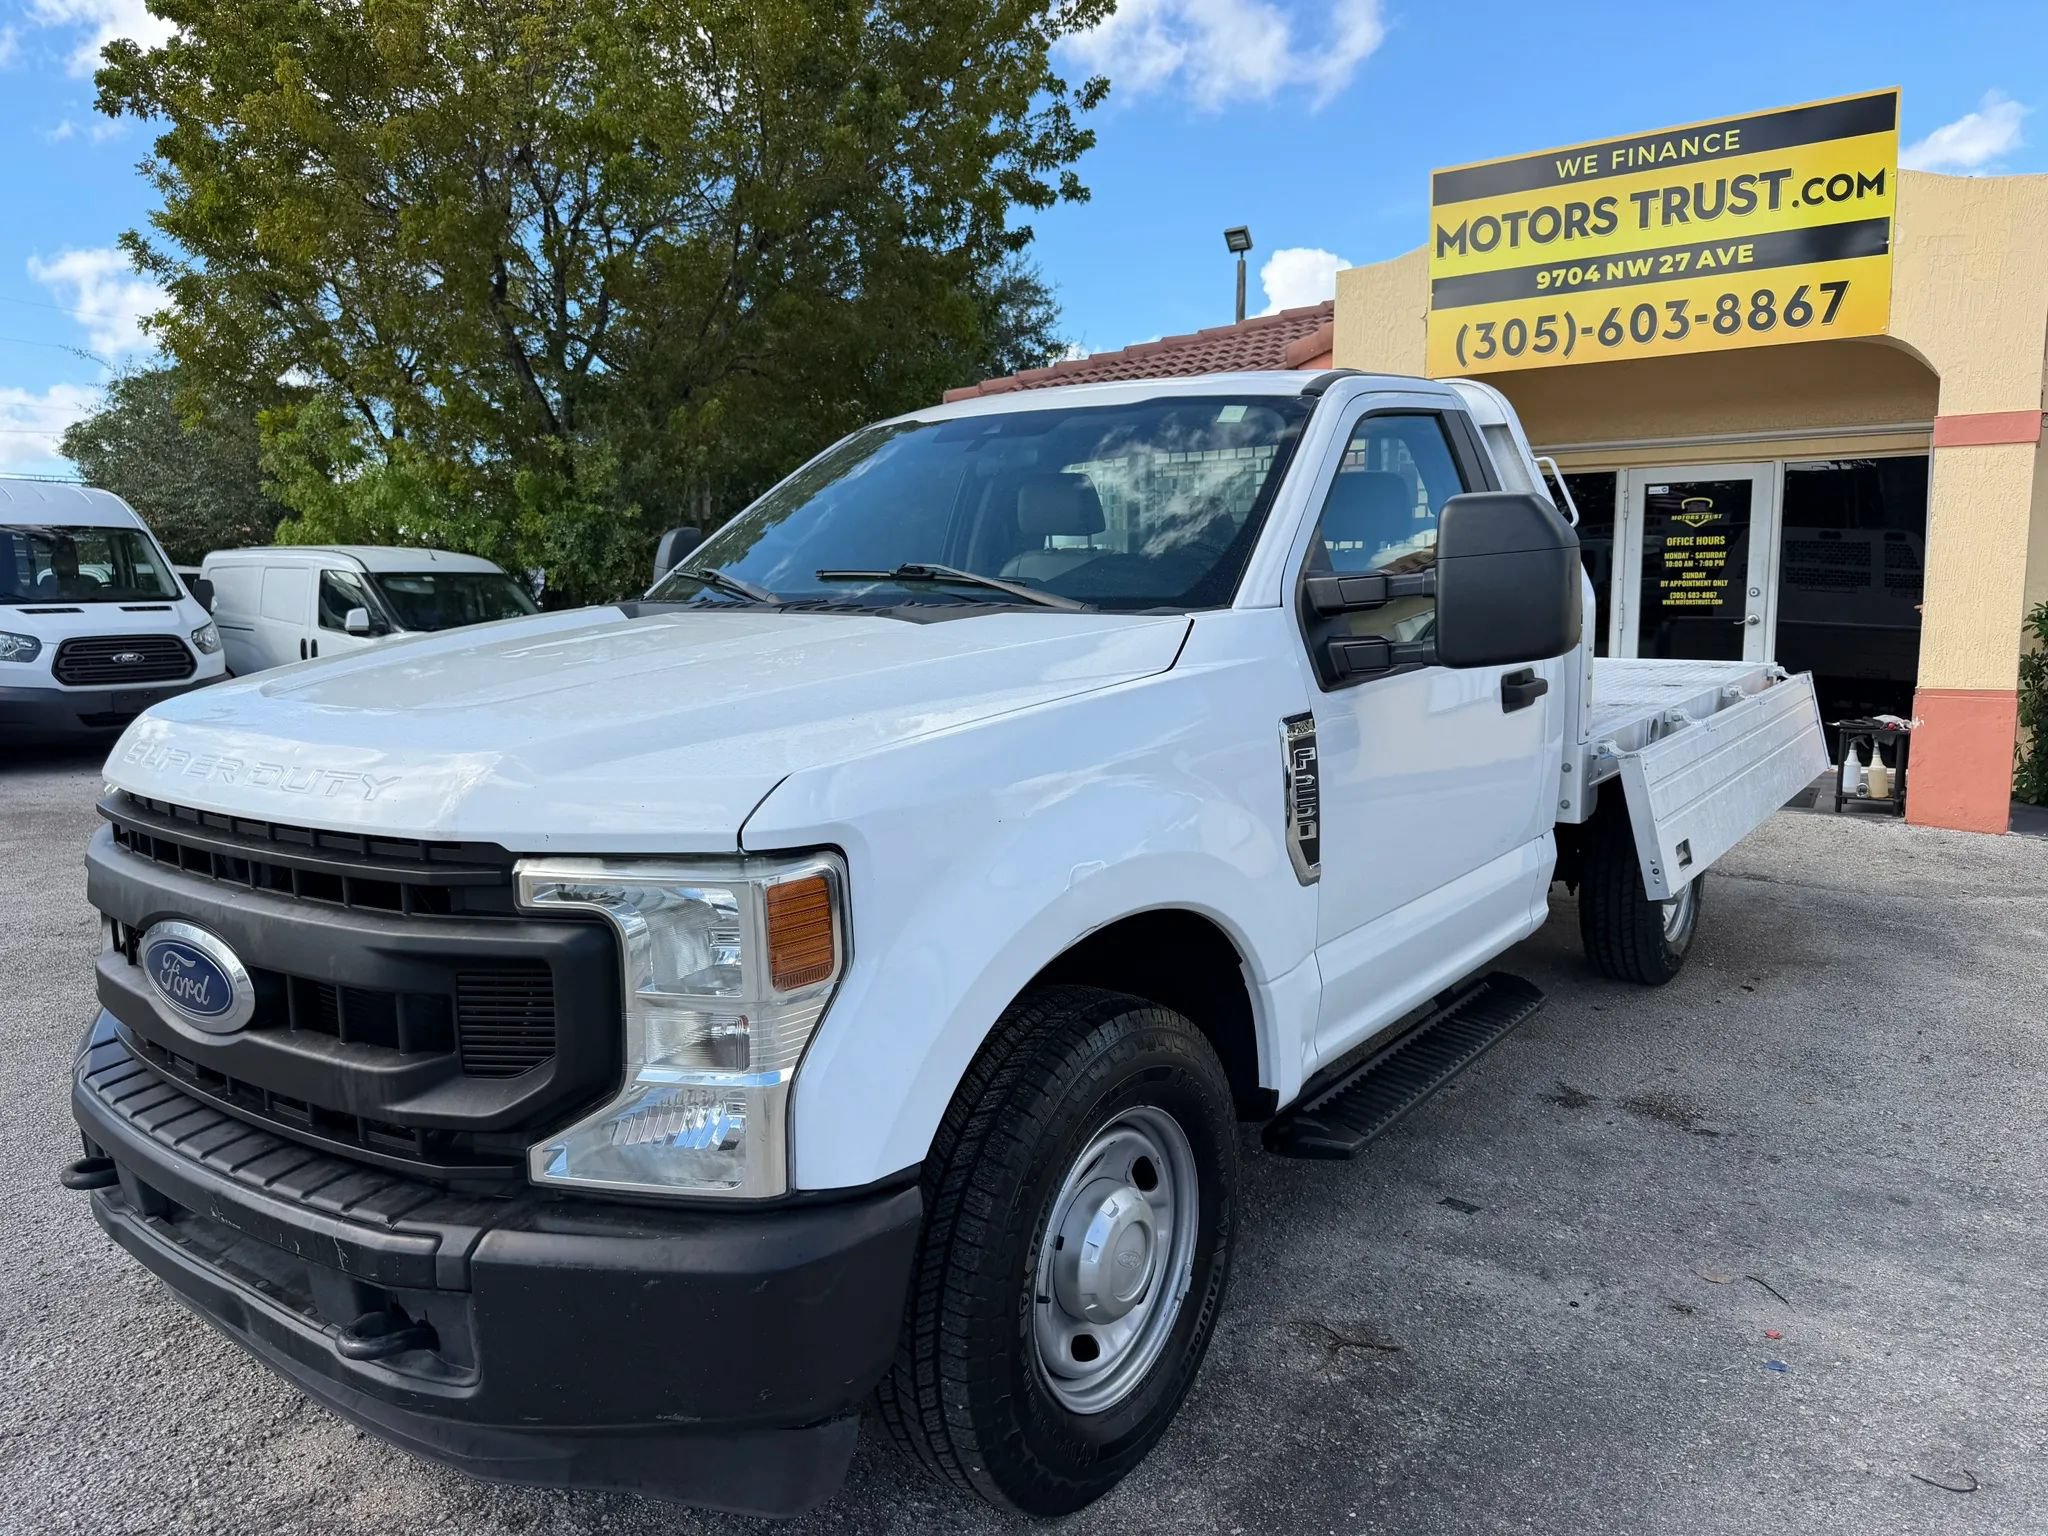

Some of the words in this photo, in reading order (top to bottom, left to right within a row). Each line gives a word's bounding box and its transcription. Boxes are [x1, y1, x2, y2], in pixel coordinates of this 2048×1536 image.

[1556, 154, 1598, 178] WE
[1612, 129, 1741, 170] FINANCE
[1436, 196, 1619, 259] MOTORS
[1536, 264, 1601, 289] 9704
[1606, 257, 1654, 281] NW
[1659, 252, 1691, 274] 27
[1696, 243, 1754, 269] AVE
[1455, 279, 1852, 369] (305)-603-8867
[1664, 552, 1689, 560] MONDAY
[1695, 551, 1727, 559] SATURDAY
[1666, 536, 1694, 546] OFFICE
[1696, 536, 1726, 546] HOURS
[1714, 559, 1725, 567] PM
[1660, 580, 1669, 588] BY
[1712, 579, 1729, 587] ONLY
[1682, 571, 1706, 579] SUNDAY
[123, 741, 245, 785] SUPER
[250, 761, 403, 800] DUTY
[159, 950, 211, 1005] Ford
